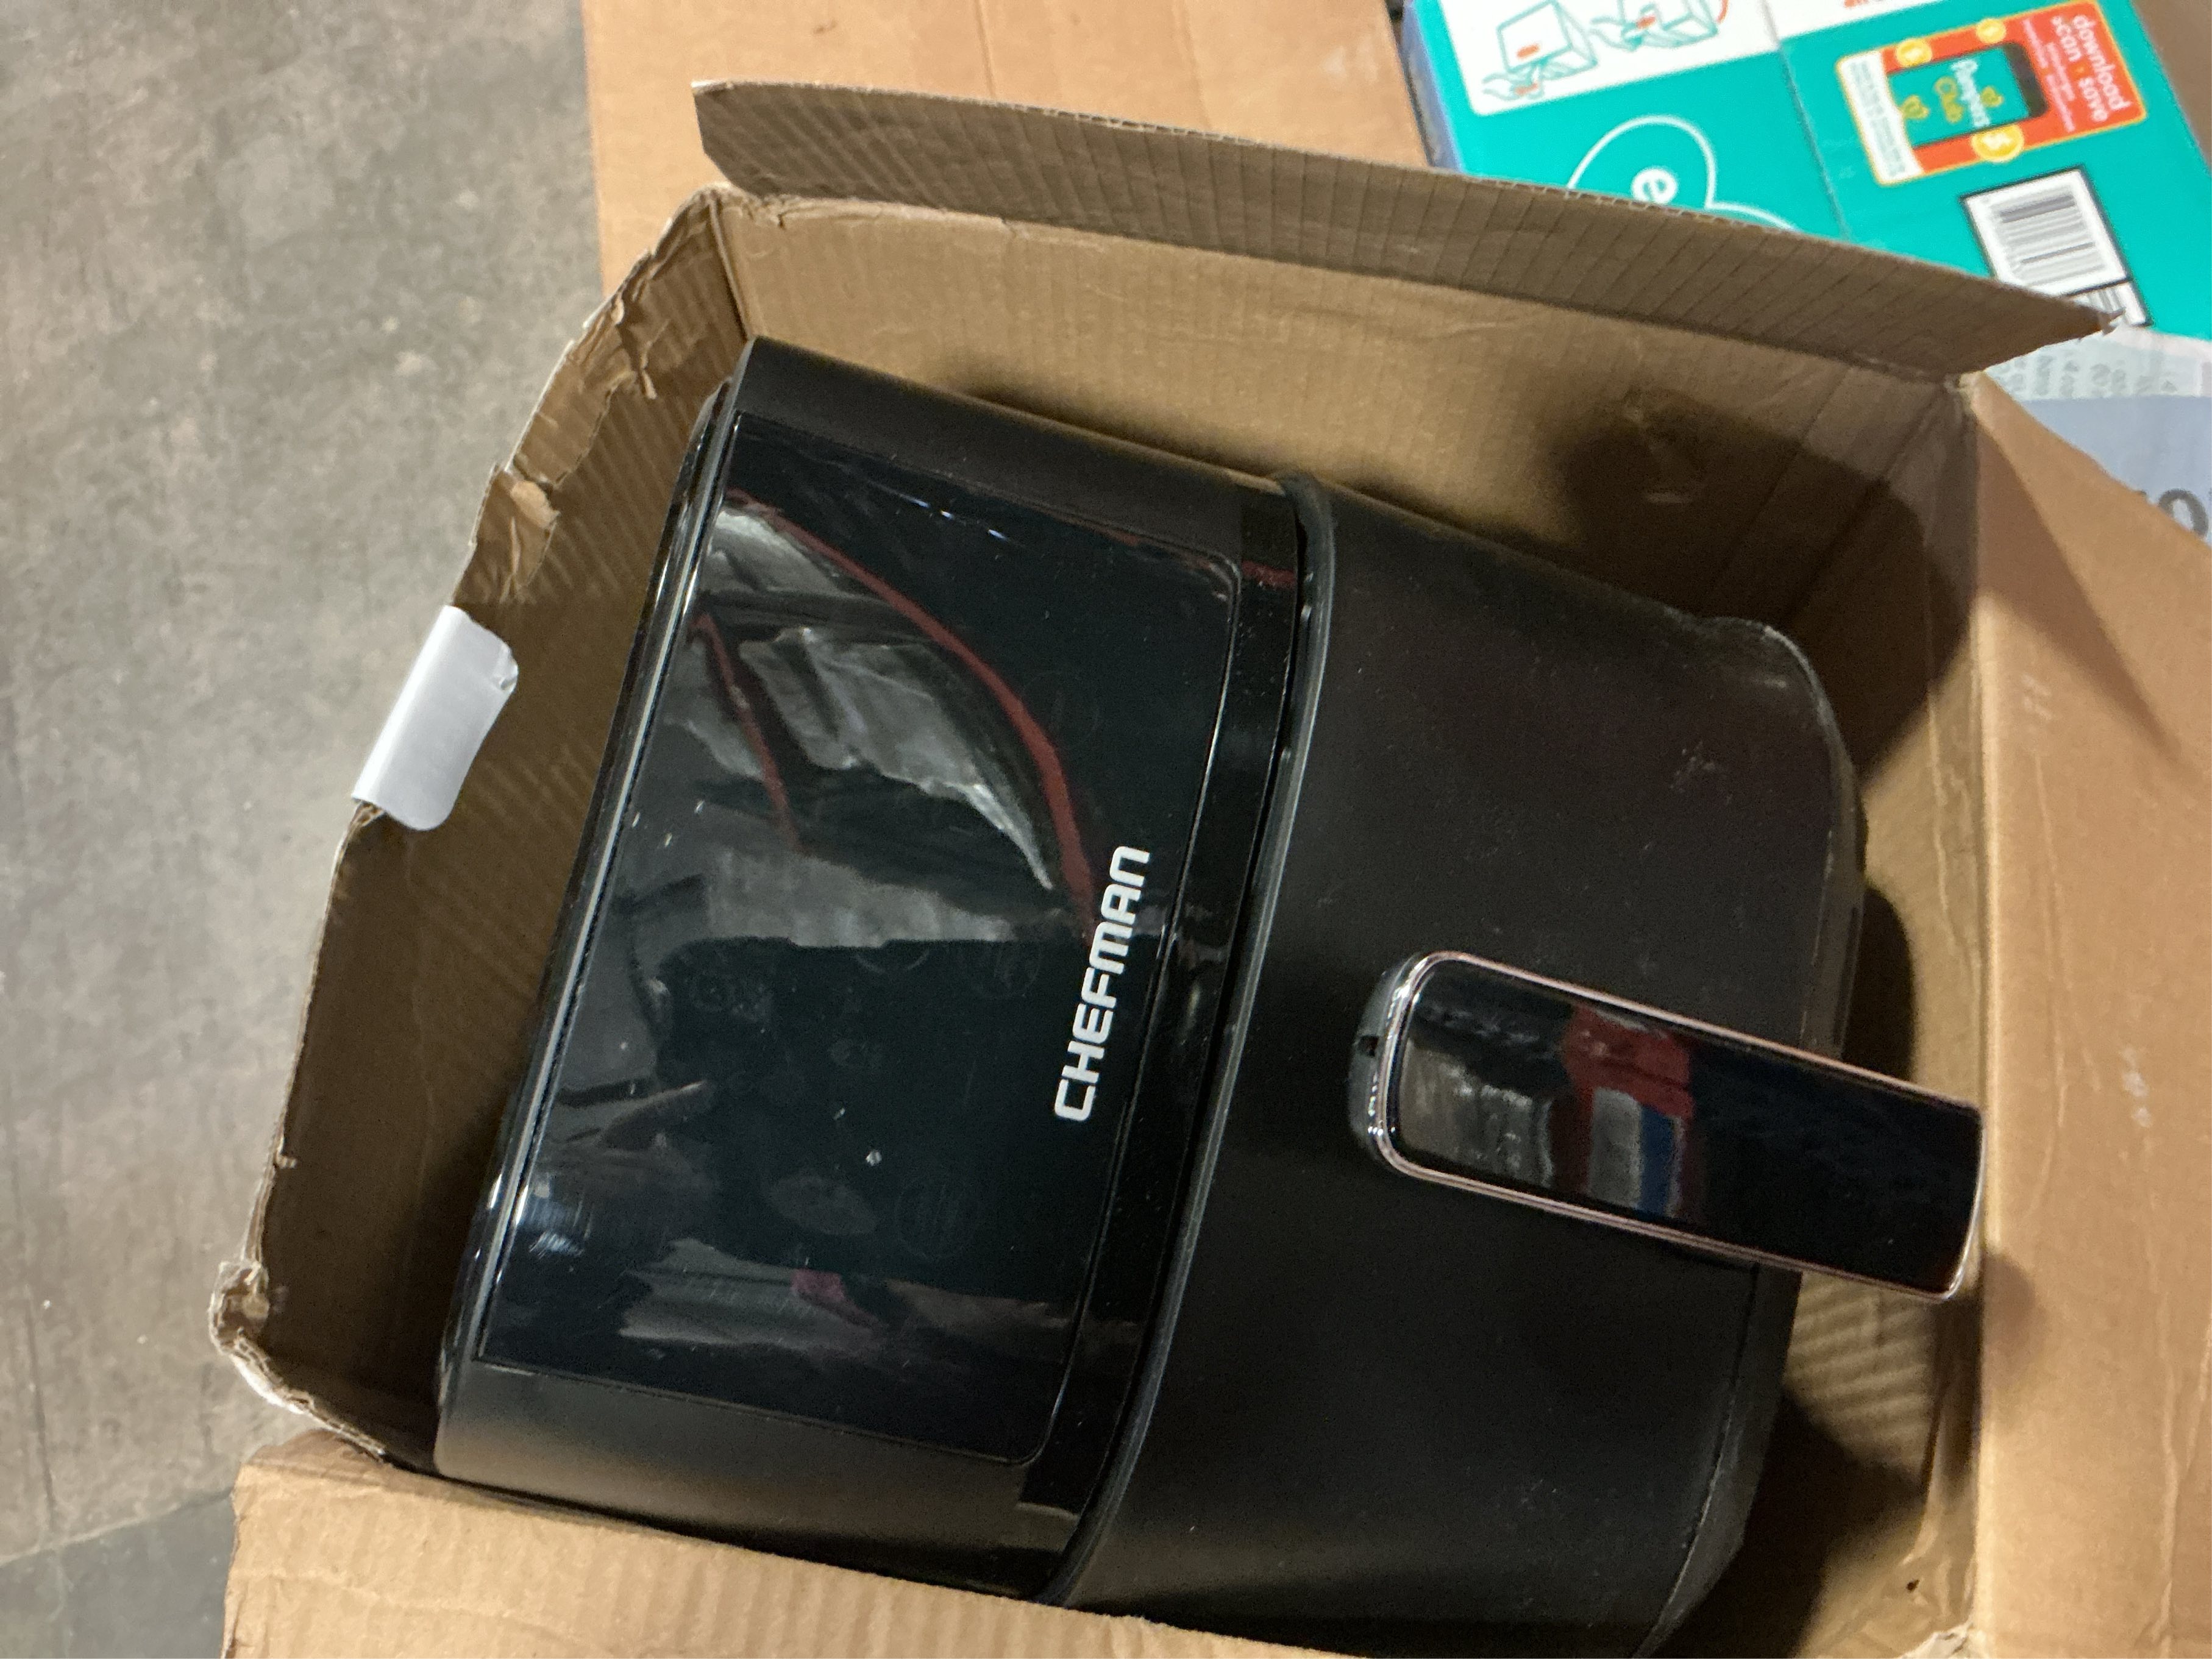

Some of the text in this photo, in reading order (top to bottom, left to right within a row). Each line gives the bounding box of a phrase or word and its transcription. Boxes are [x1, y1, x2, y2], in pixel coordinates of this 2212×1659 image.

[2052, 16, 2082, 62] scan
[2078, 77, 2108, 122] save
[2072, 15, 2132, 110] download
[1054, 846, 1150, 1121] CHEFMAN
